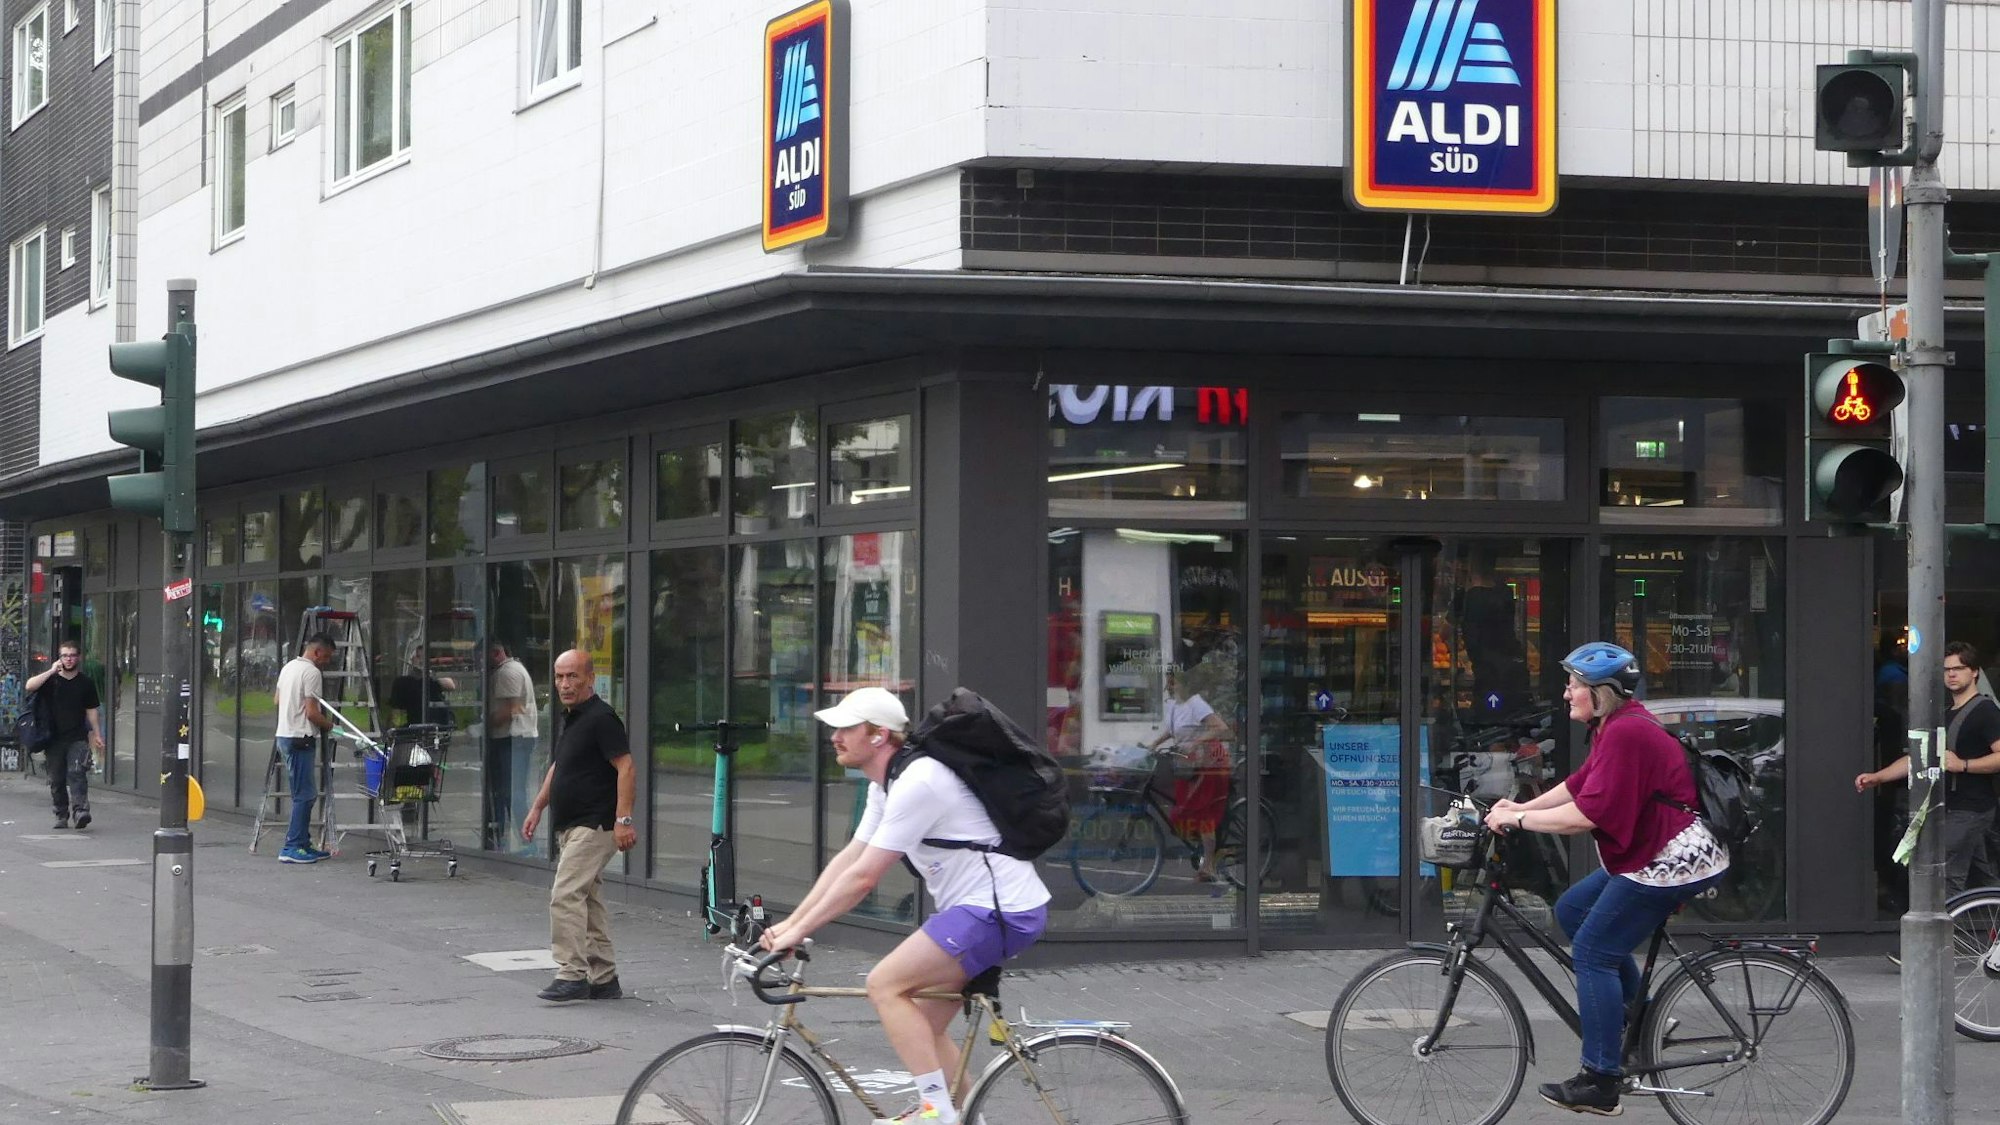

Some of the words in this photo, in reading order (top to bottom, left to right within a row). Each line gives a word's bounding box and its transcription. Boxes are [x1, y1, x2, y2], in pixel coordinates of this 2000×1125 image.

[1387, 101, 1519, 146] ALDI
[775, 137, 820, 189] ALDI
[1430, 146, 1479, 173] SÜD
[789, 184, 806, 210] SÜD
[1123, 647, 1169, 660] Herzlich
[1329, 742, 1370, 751] UNSERE
